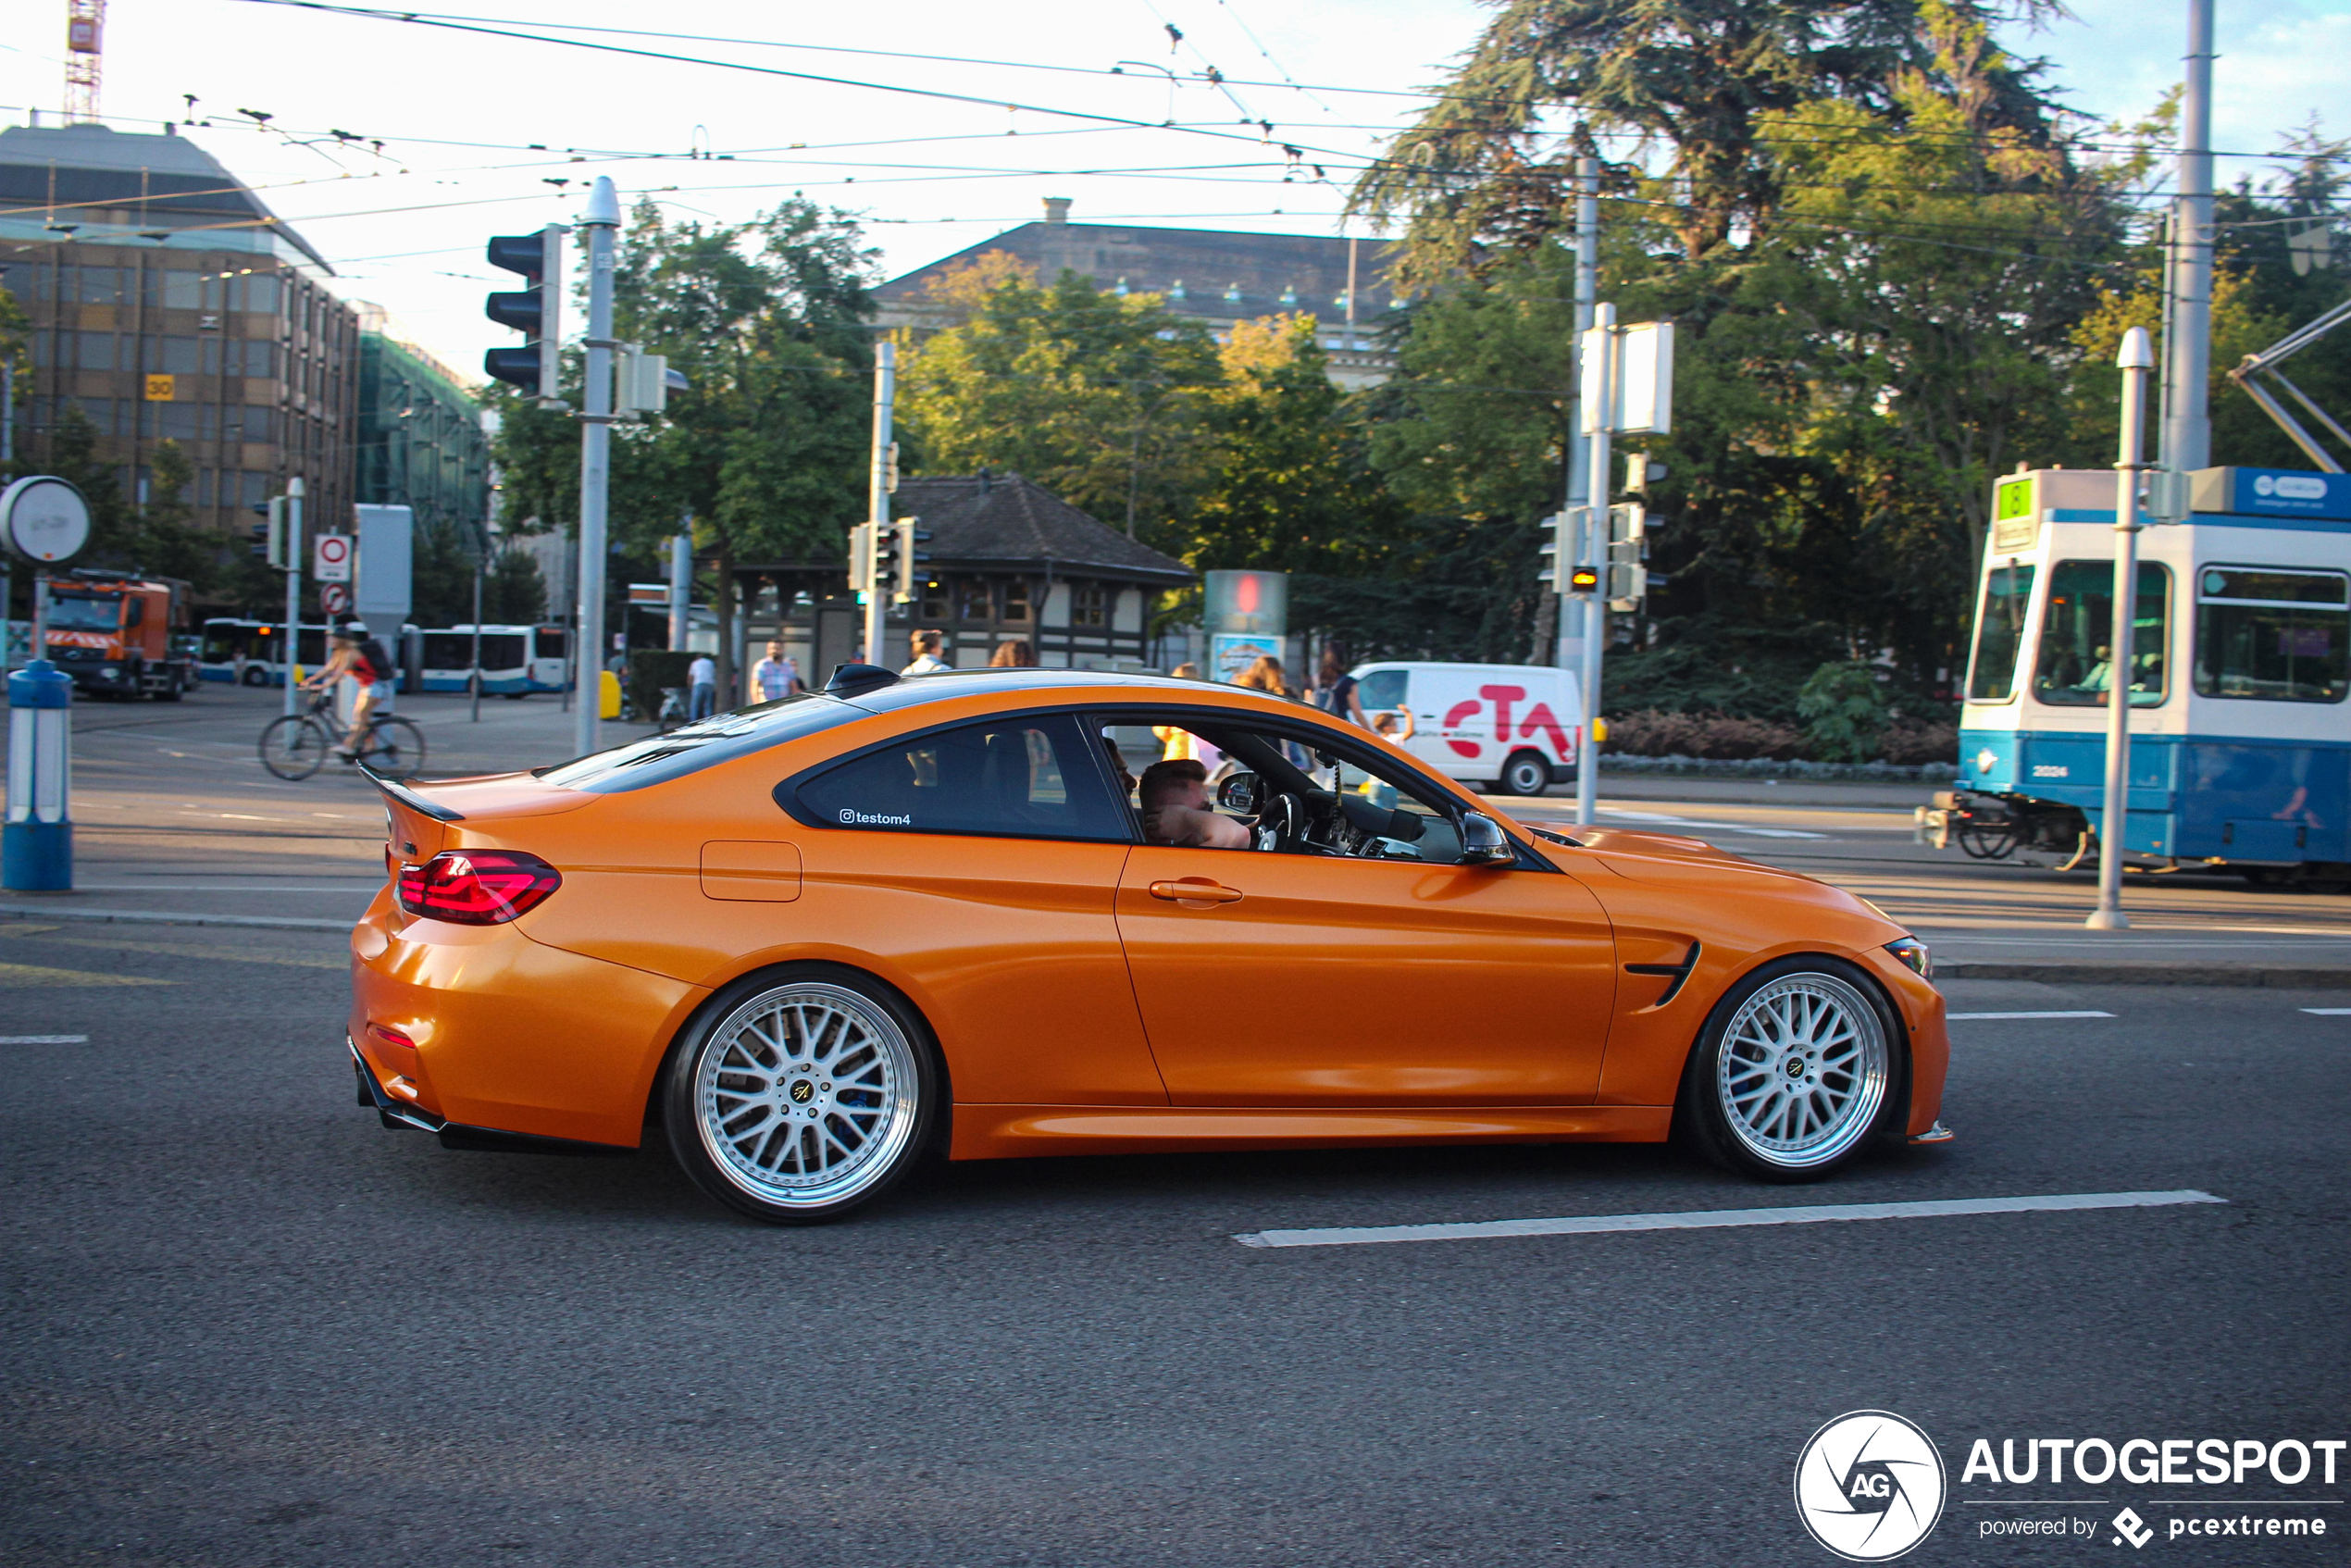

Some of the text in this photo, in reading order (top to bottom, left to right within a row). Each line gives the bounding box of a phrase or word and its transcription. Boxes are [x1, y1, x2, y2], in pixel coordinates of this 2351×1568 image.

[146, 380, 173, 395] 30
[2009, 484, 2022, 515] 8
[1443, 684, 1575, 762] CTA
[856, 812, 911, 825] testom4
